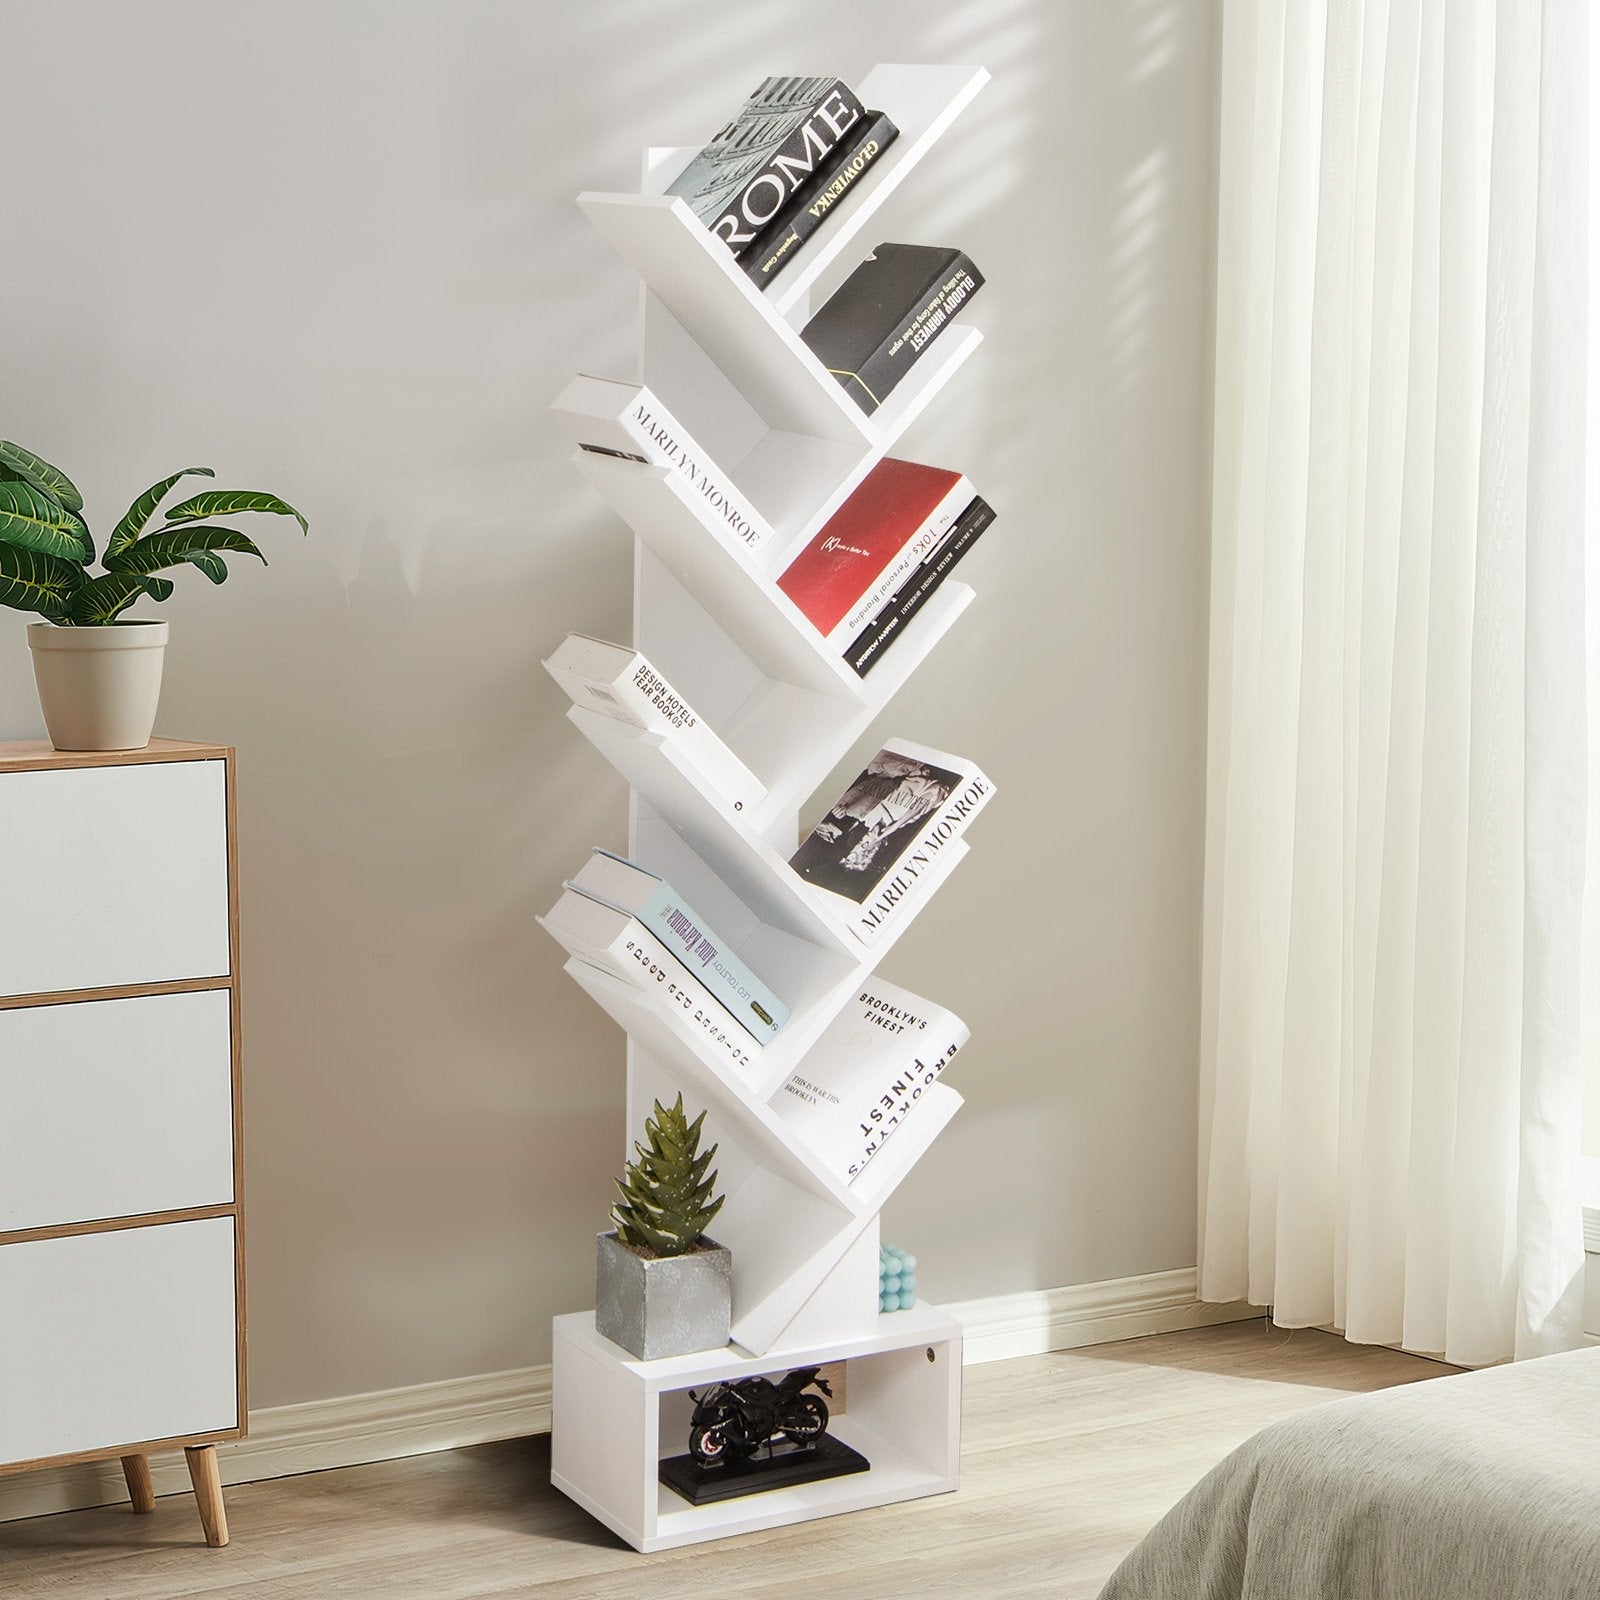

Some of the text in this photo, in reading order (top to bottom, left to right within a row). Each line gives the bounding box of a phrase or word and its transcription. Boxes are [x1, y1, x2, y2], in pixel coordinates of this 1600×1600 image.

[711, 90, 858, 260] ROME
[910, 275, 975, 352] BLOODY HARVEST
[633, 406, 760, 547] MARILYN MONROE
[913, 528, 937, 554] 10Ks
[880, 562, 909, 595] Personal
[849, 595, 880, 628] Branding
[633, 673, 653, 697] YEAR
[639, 665, 696, 727] DESIGN HOTELS
[862, 777, 988, 933] MARILYN MONROE
[667, 908, 751, 1001] LEO TOLSTOY Anna Karenina
[859, 993, 927, 1030] BROOKLYN'S
[864, 1011, 904, 1034] FINEST
[792, 1075, 807, 1087] THIS
[848, 1044, 957, 1175] BROOKLYN'S
[860, 1059, 924, 1137] FINEST
